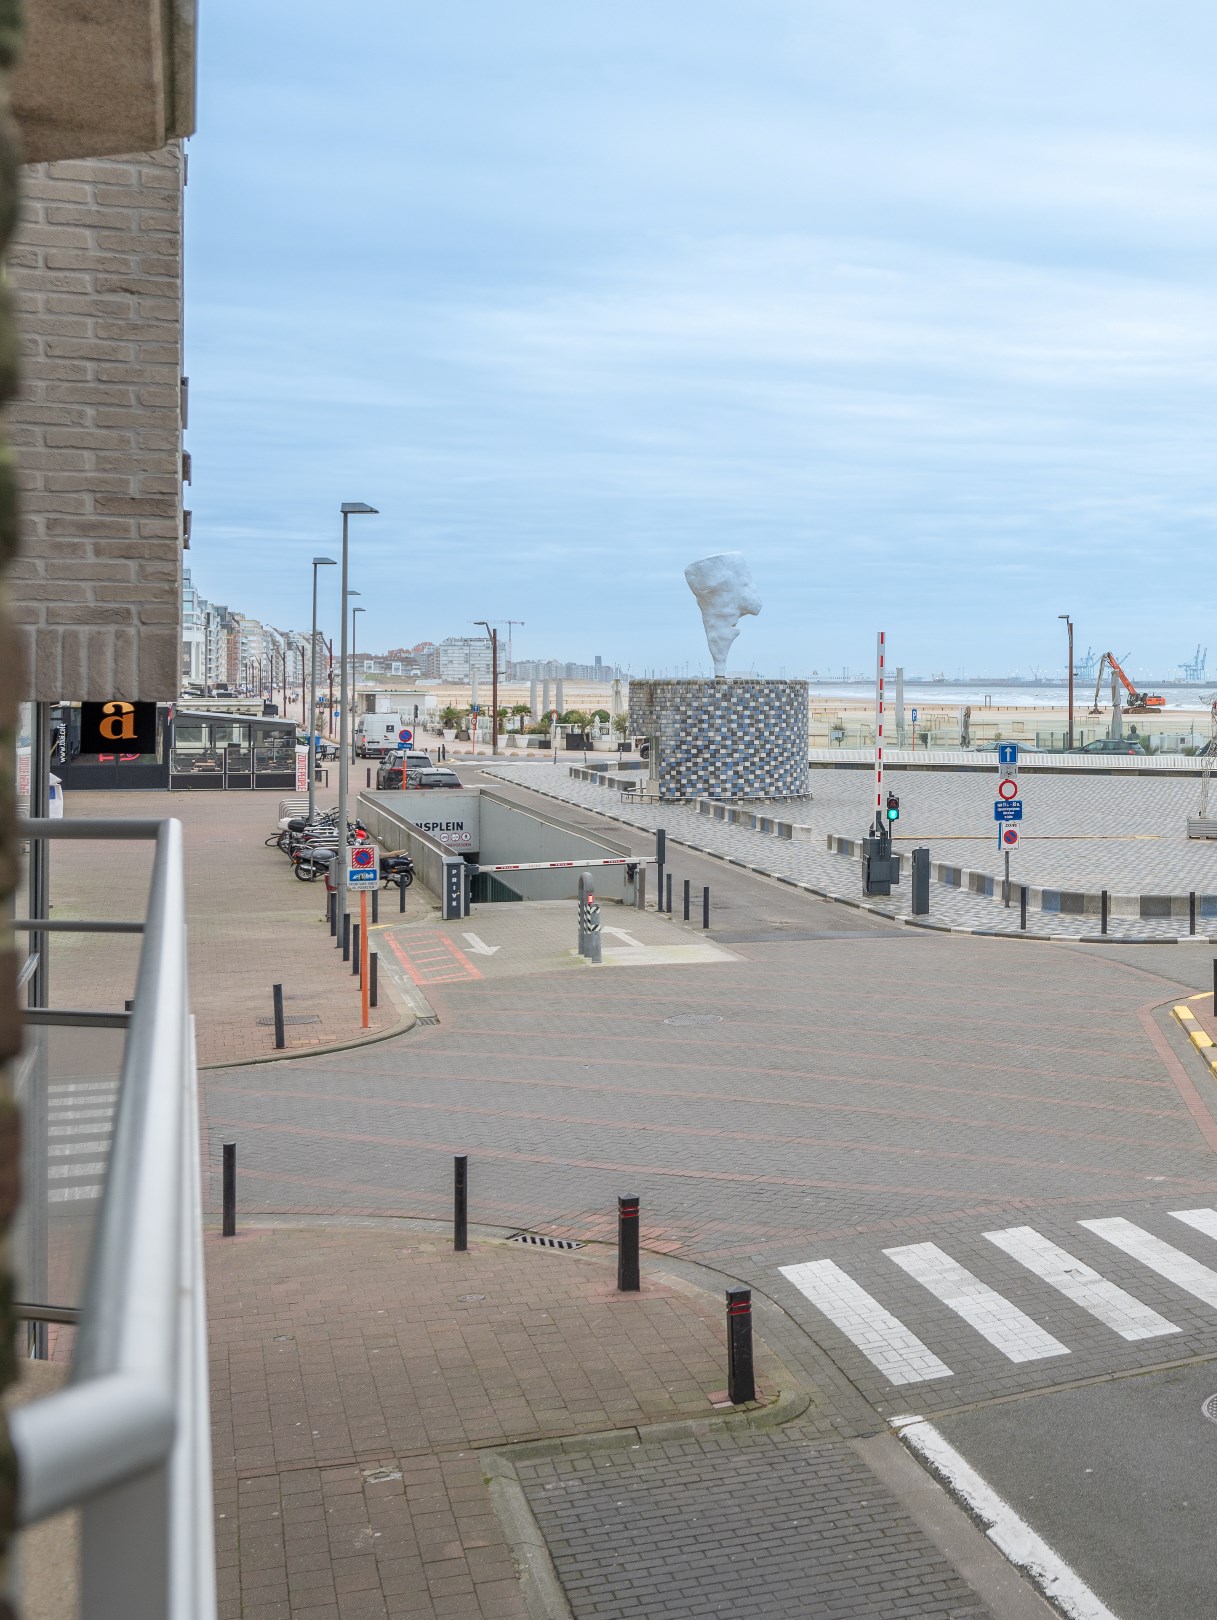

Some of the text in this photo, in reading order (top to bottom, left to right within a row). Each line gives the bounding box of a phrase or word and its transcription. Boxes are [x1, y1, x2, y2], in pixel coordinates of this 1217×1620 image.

[99, 701, 138, 740] a
[298, 772, 307, 791] PEOPLE
[413, 822, 464, 831] NSPLEIN
